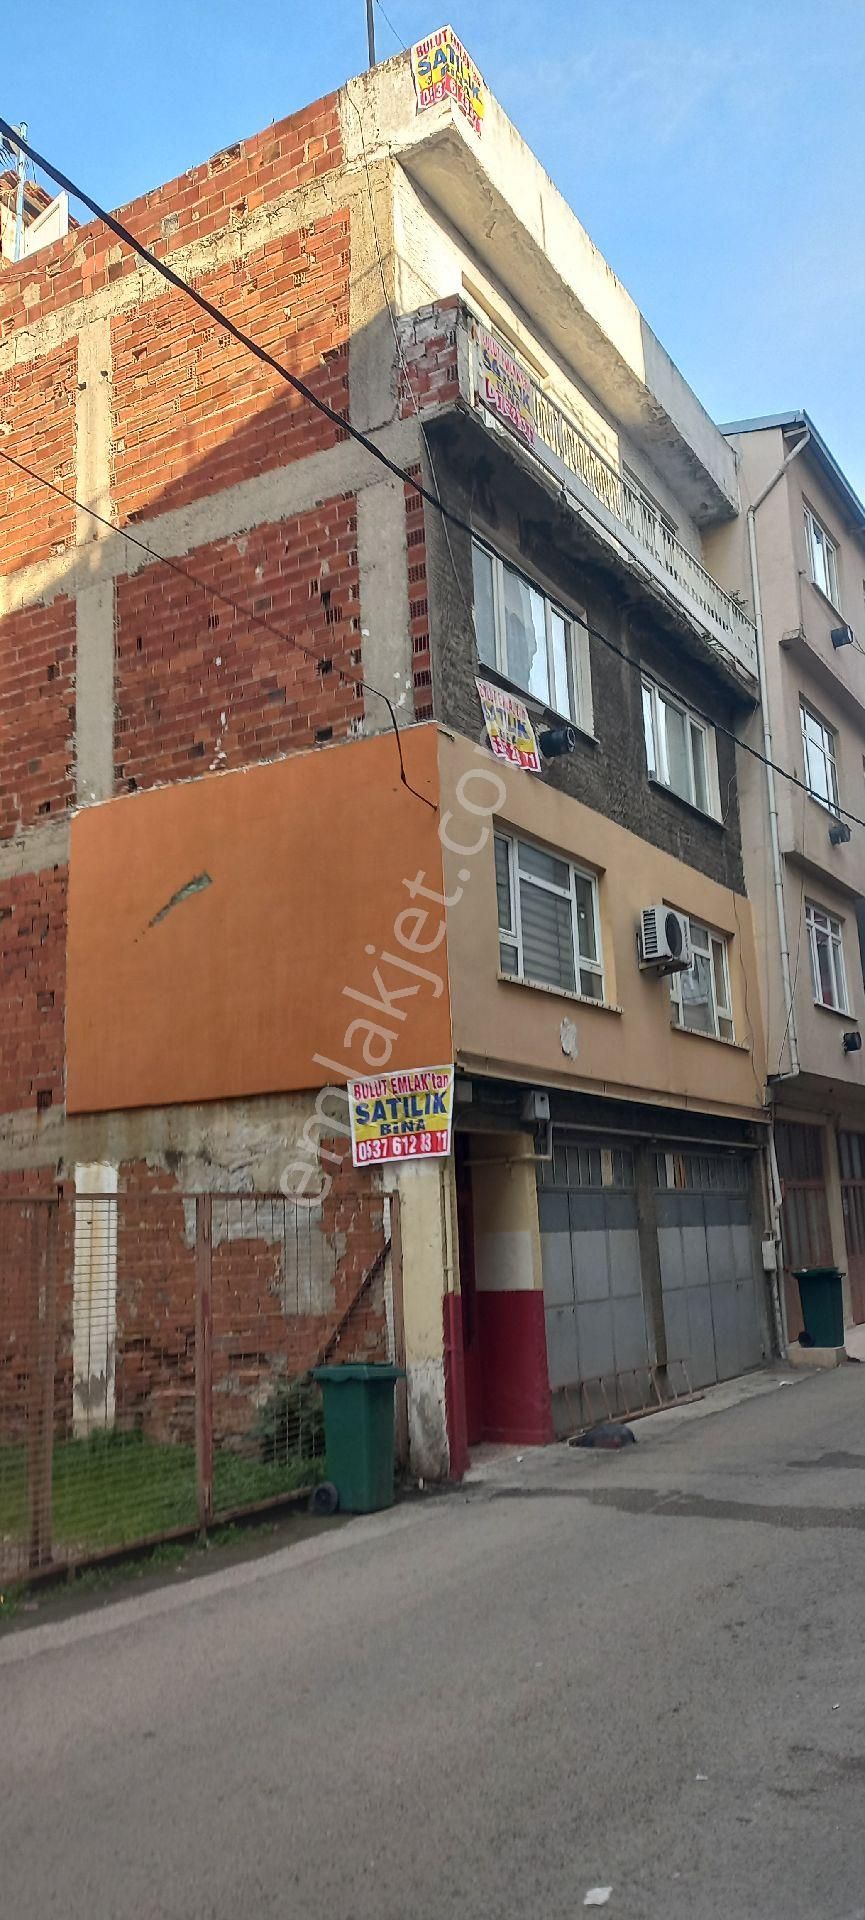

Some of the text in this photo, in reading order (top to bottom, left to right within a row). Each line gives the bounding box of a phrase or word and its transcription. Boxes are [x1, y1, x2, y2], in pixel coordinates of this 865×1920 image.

[416, 29, 448, 57] BULUT
[353, 1072, 449, 1101] BULUT EMLAK'tan
[355, 1090, 448, 1126] SATILIK
[358, 1138, 388, 1161] 0537
[392, 1135, 417, 1155] 612
